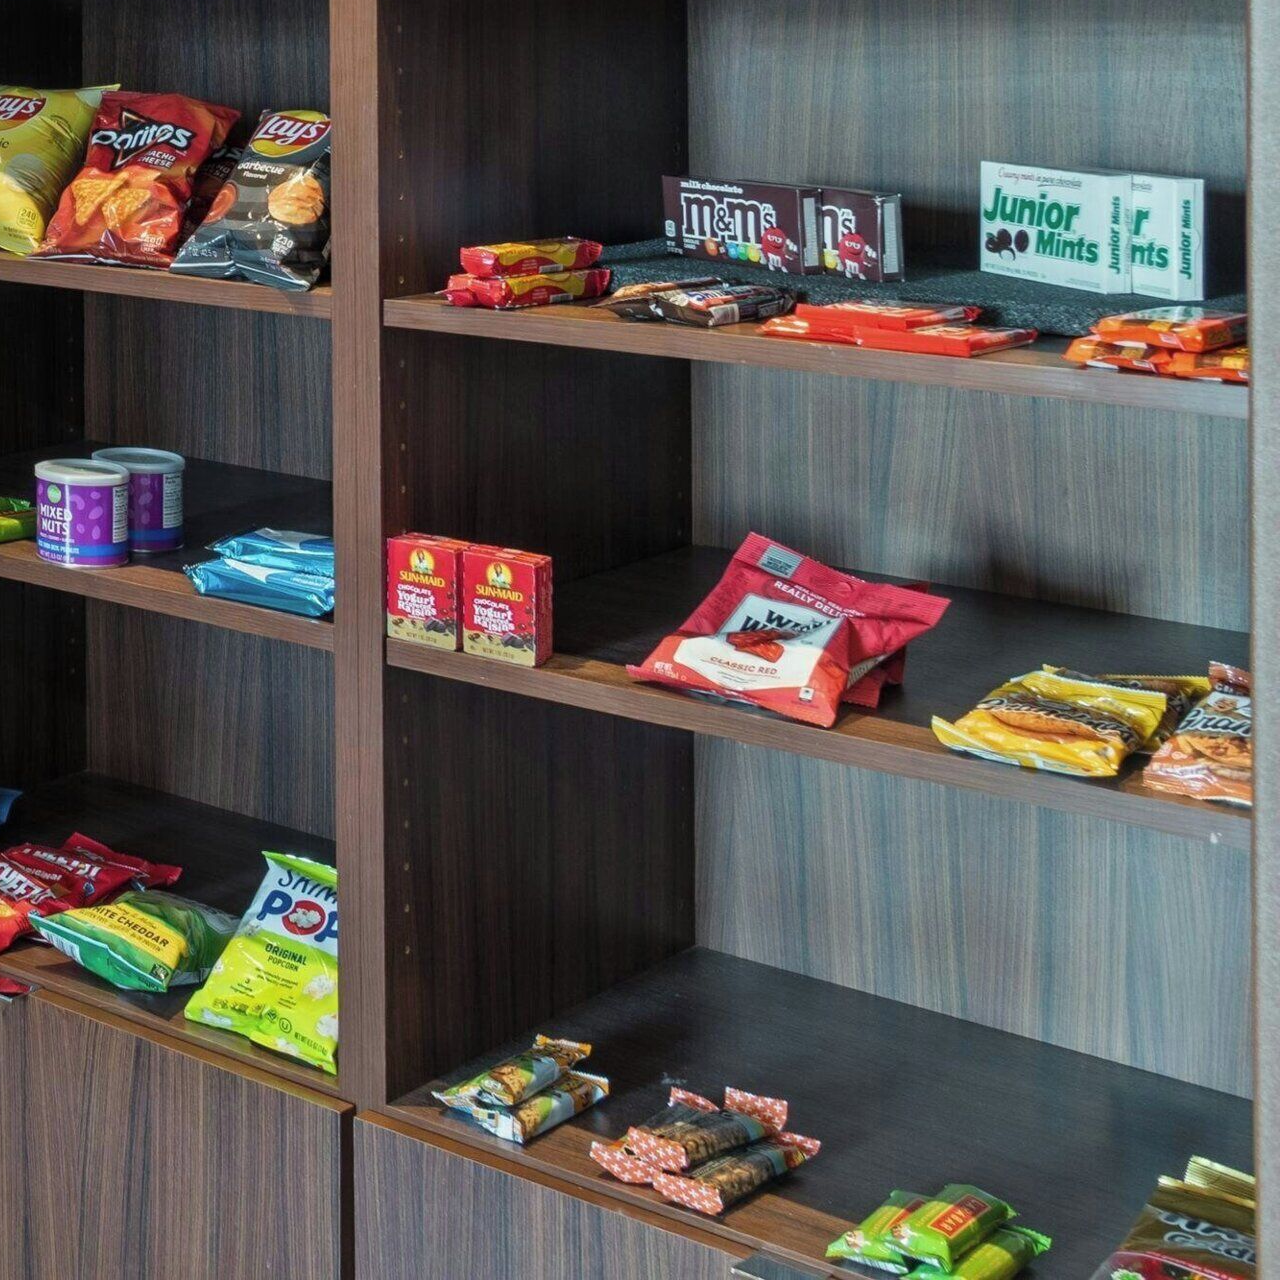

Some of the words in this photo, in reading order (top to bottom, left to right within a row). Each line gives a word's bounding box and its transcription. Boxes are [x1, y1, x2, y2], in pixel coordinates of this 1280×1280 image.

[92, 122, 193, 152] Doritos
[254, 115, 326, 146] Lay's
[983, 186, 1080, 232] Junior
[1111, 196, 1120, 226] Mints
[1182, 199, 1191, 229] Mints
[1035, 229, 1099, 264] Mints
[1109, 230, 1121, 274] Junior
[1180, 231, 1191, 280] Junior
[40, 503, 73, 520] MIXED
[42, 519, 69, 535] NUTS
[399, 570, 445, 588] SUN-MAID
[397, 590, 436, 605] Yogurt
[476, 584, 523, 602] SUN-MAID
[774, 580, 812, 604] REALLY
[473, 605, 513, 620] Yogurt
[711, 656, 756, 673] CLASSIC
[758, 665, 778, 674] RED
[116, 914, 169, 947] CHEDDAR
[265, 942, 307, 965] ORIGINAL
[267, 955, 299, 972] POPCORN
